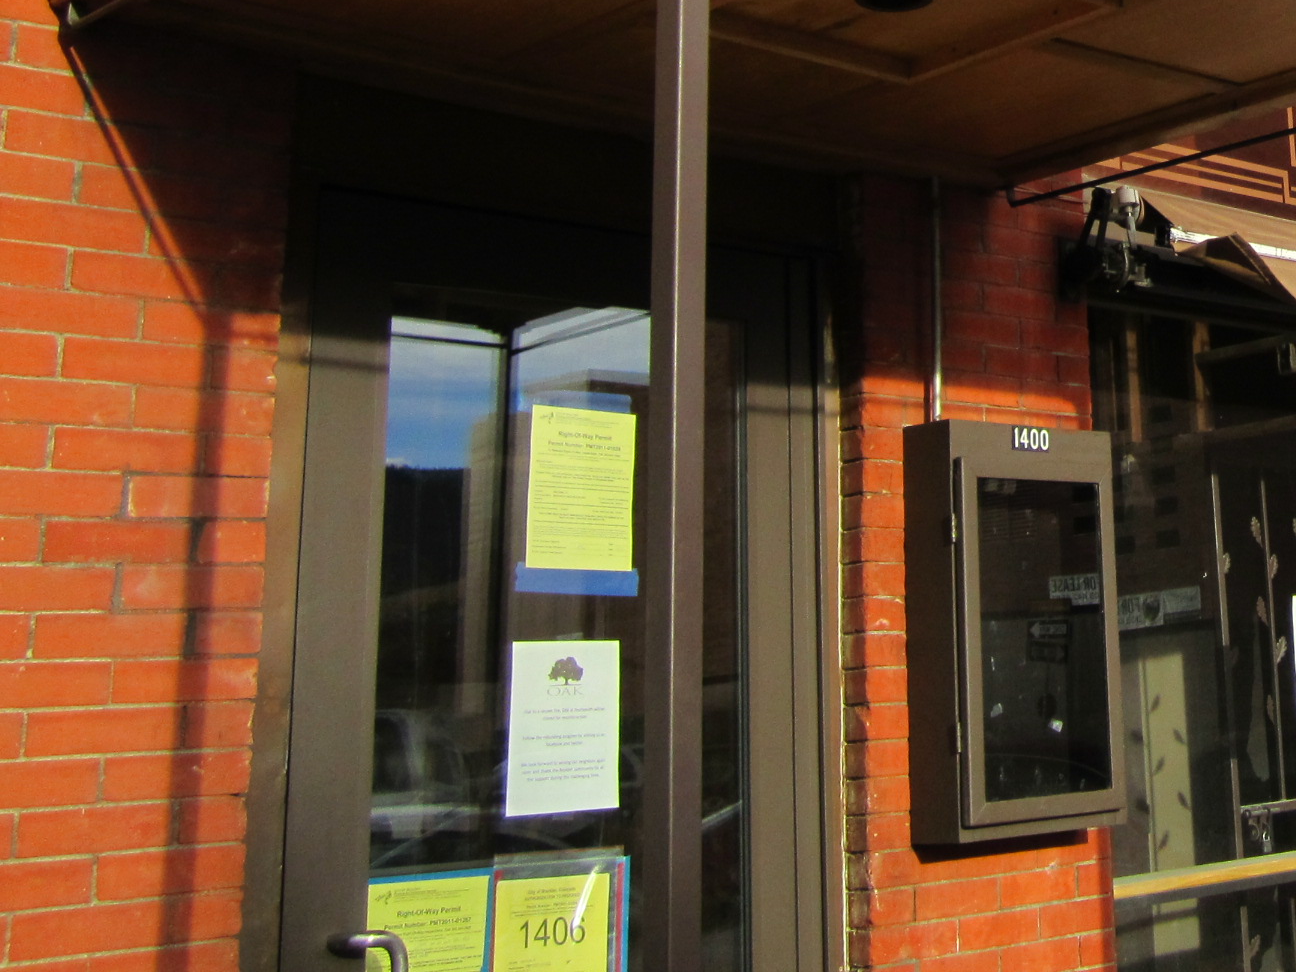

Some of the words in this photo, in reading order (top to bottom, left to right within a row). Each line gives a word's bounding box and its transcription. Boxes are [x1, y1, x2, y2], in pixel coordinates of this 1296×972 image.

[1013, 426, 1049, 451] 1400
[546, 686, 584, 697] OAK
[440, 905, 461, 914] Permit
[519, 916, 586, 949] 1406
